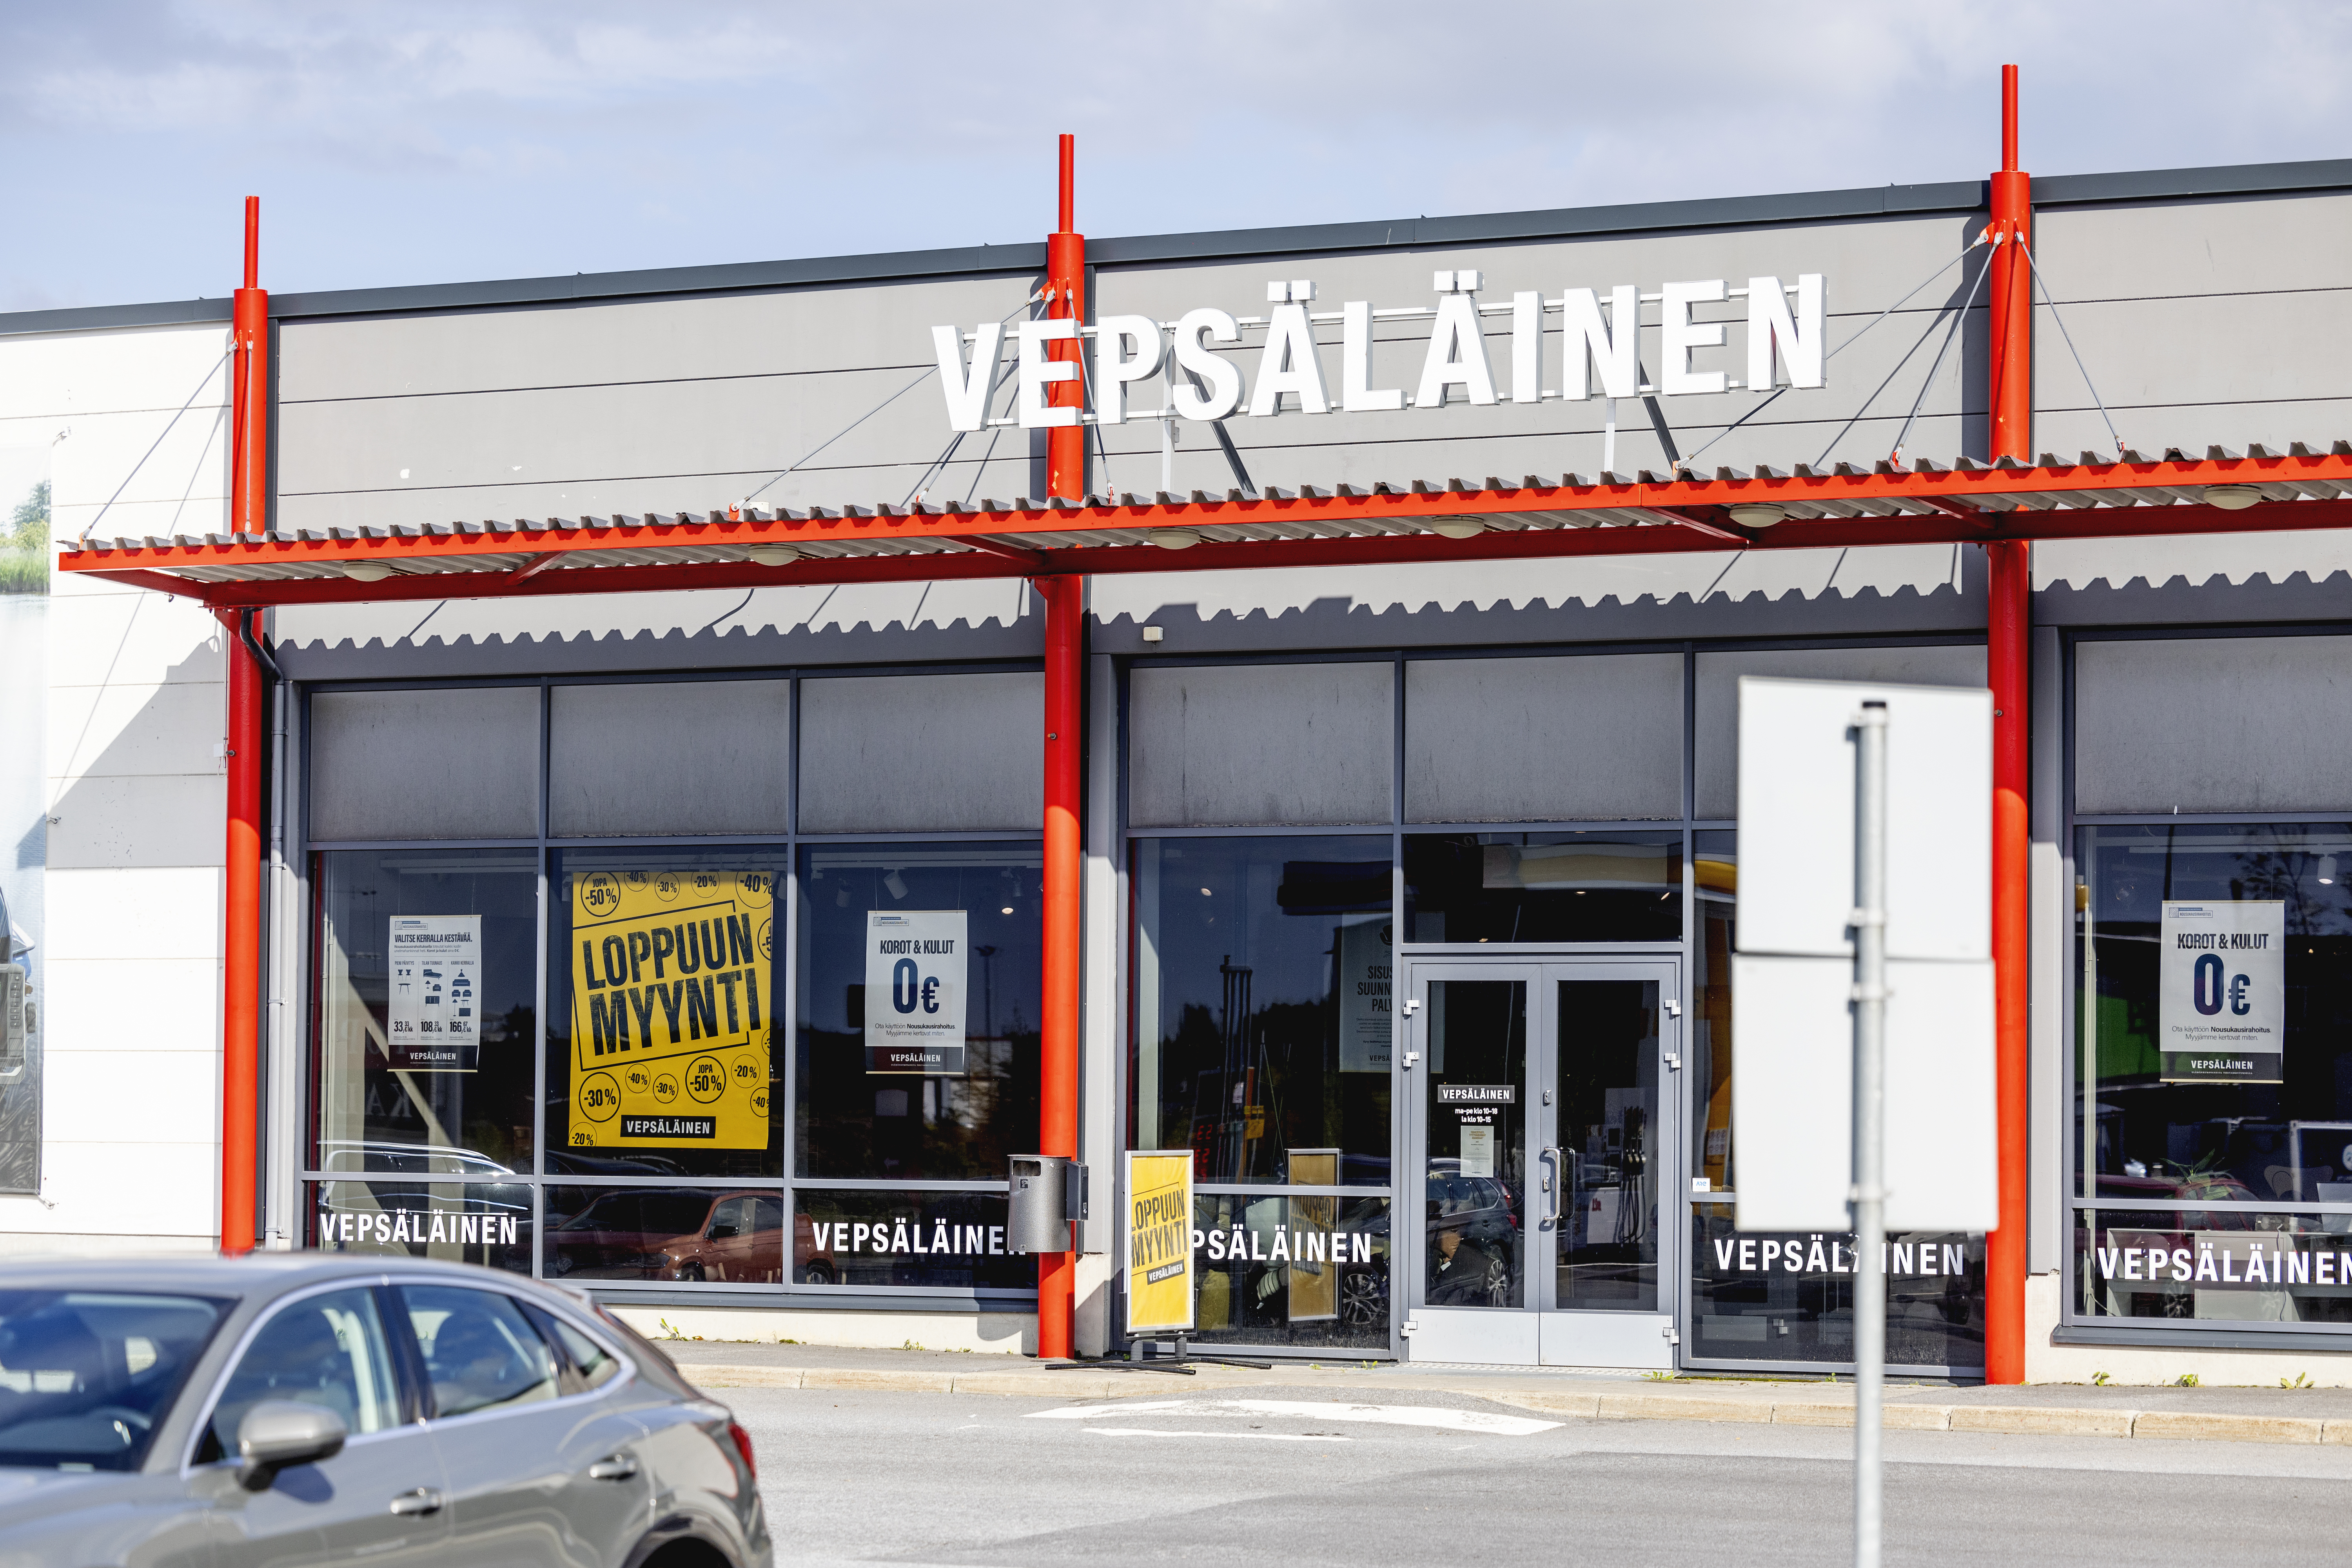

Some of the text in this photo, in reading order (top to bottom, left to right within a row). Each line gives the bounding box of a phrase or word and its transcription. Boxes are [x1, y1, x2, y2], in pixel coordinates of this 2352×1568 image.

[932, 270, 1828, 432] VEPSÄLÄINEN
[592, 878, 607, 888] JOPA
[445, 932, 473, 942] KESTÄVÄÄ.
[2178, 934, 2269, 949] KOROT & KULUT
[582, 912, 755, 991] LOPPUUN
[880, 940, 954, 954] KOROT & KULUT
[893, 958, 939, 1013] 0 €
[1357, 982, 1391, 995] SUUNN
[2194, 954, 2250, 1015] 0 €
[589, 967, 762, 1057] MYYNTI
[2184, 1025, 2209, 1034] käyttöön
[891, 1053, 940, 1062] VEPSÄLÄINEN
[2191, 1059, 2252, 1069] VEPSÄLÄINEN
[698, 1064, 713, 1073] JOPA
[1443, 1088, 1510, 1100] VEPSÄLÄINEN
[627, 1119, 710, 1133] VEPSÄLÄINEN
[1132, 1189, 1185, 1232] OPPUUN
[320, 1209, 516, 1244] VEPSÄLÄINEN
[812, 1218, 1025, 1255] VEPSÄLÄINE
[1132, 1218, 1187, 1269] MYYNTI
[1193, 1224, 1370, 1263] PSÄLÄINEN
[1149, 1263, 1183, 1281] VEPSÄLÄINEN
